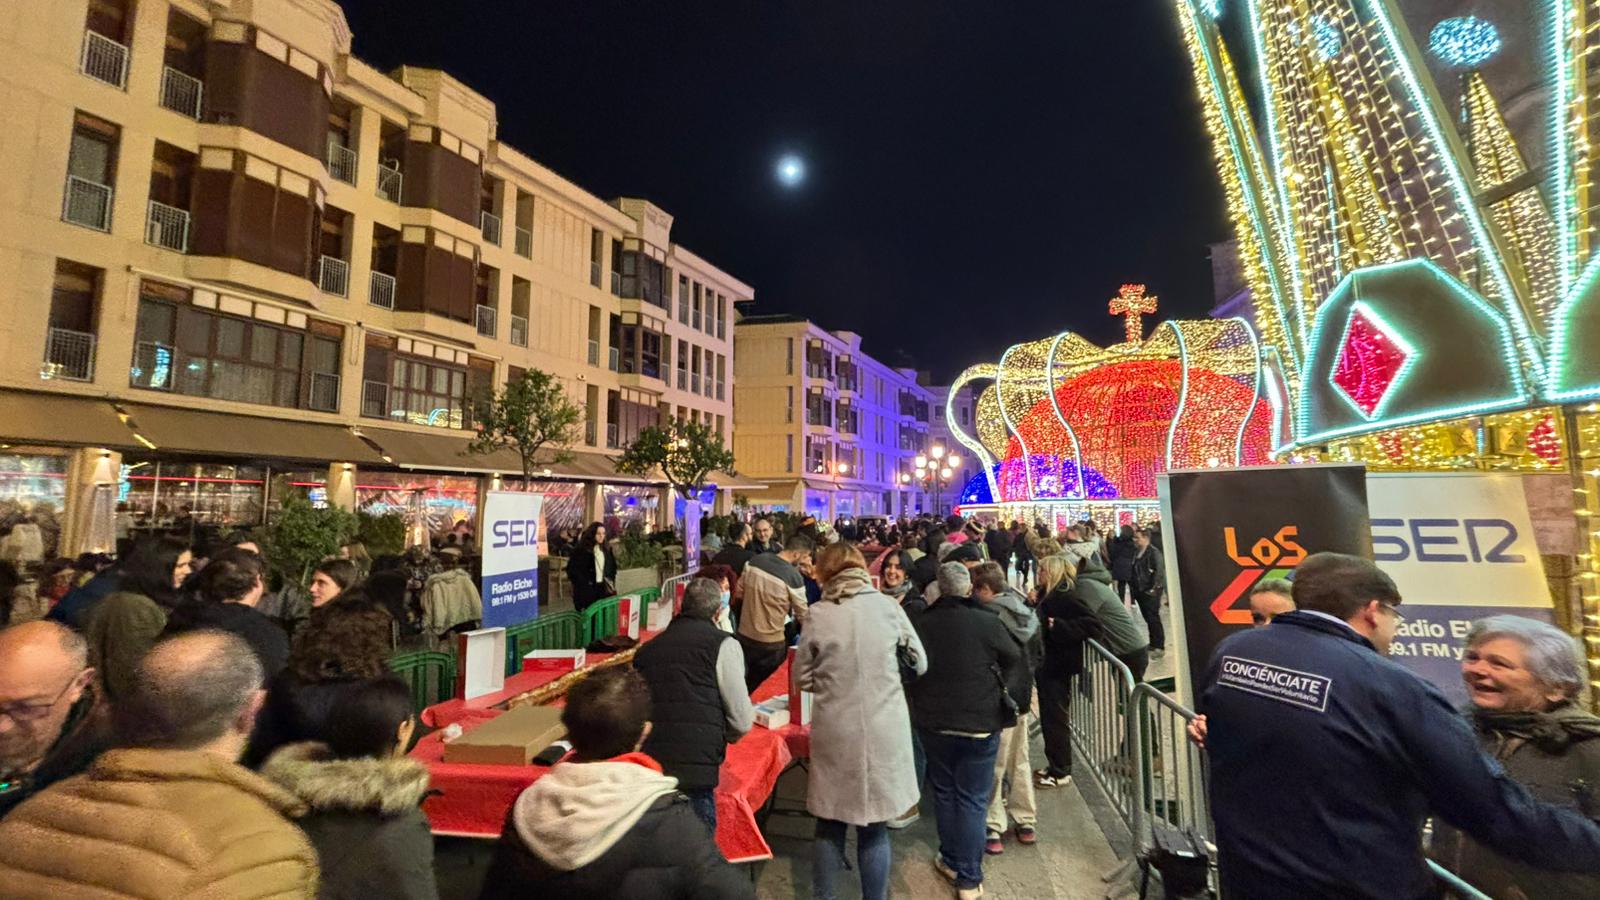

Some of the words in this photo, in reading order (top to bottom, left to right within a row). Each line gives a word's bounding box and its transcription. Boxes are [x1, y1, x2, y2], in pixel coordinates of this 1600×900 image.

[1370, 518, 1526, 563] SER
[491, 581, 512, 595] Radio
[513, 577, 533, 590] Elche
[503, 594, 512, 605] FM
[1420, 642, 1451, 657] FM
[1223, 660, 1322, 695] CONCIÉNCIATE
